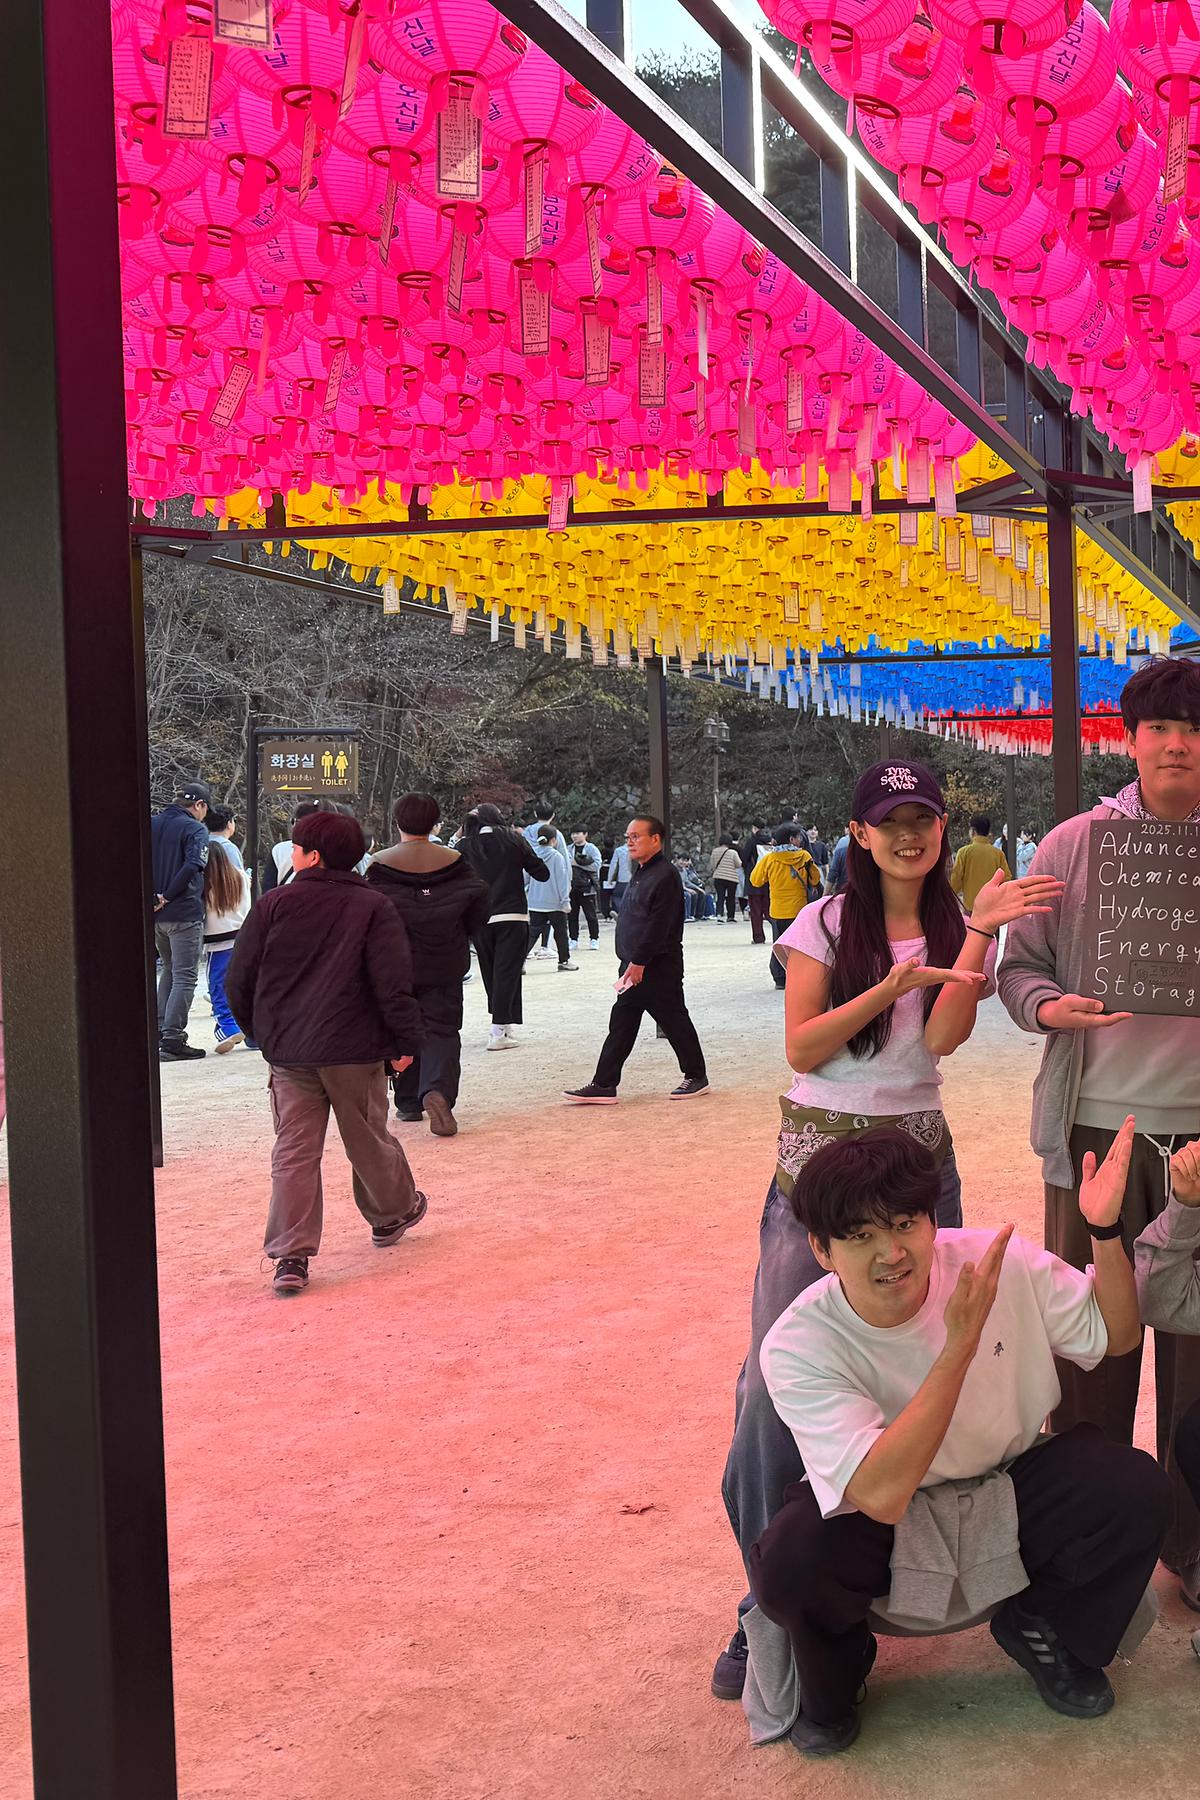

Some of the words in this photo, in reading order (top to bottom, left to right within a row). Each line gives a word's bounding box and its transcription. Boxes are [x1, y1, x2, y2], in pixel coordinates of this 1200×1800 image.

[403, 17, 437, 57] 신날
[395, 83, 420, 133] 오신날
[271, 754, 314, 768] 화장실
[885, 767, 911, 775] Type
[881, 773, 918, 785] Service
[890, 781, 914, 790] Web
